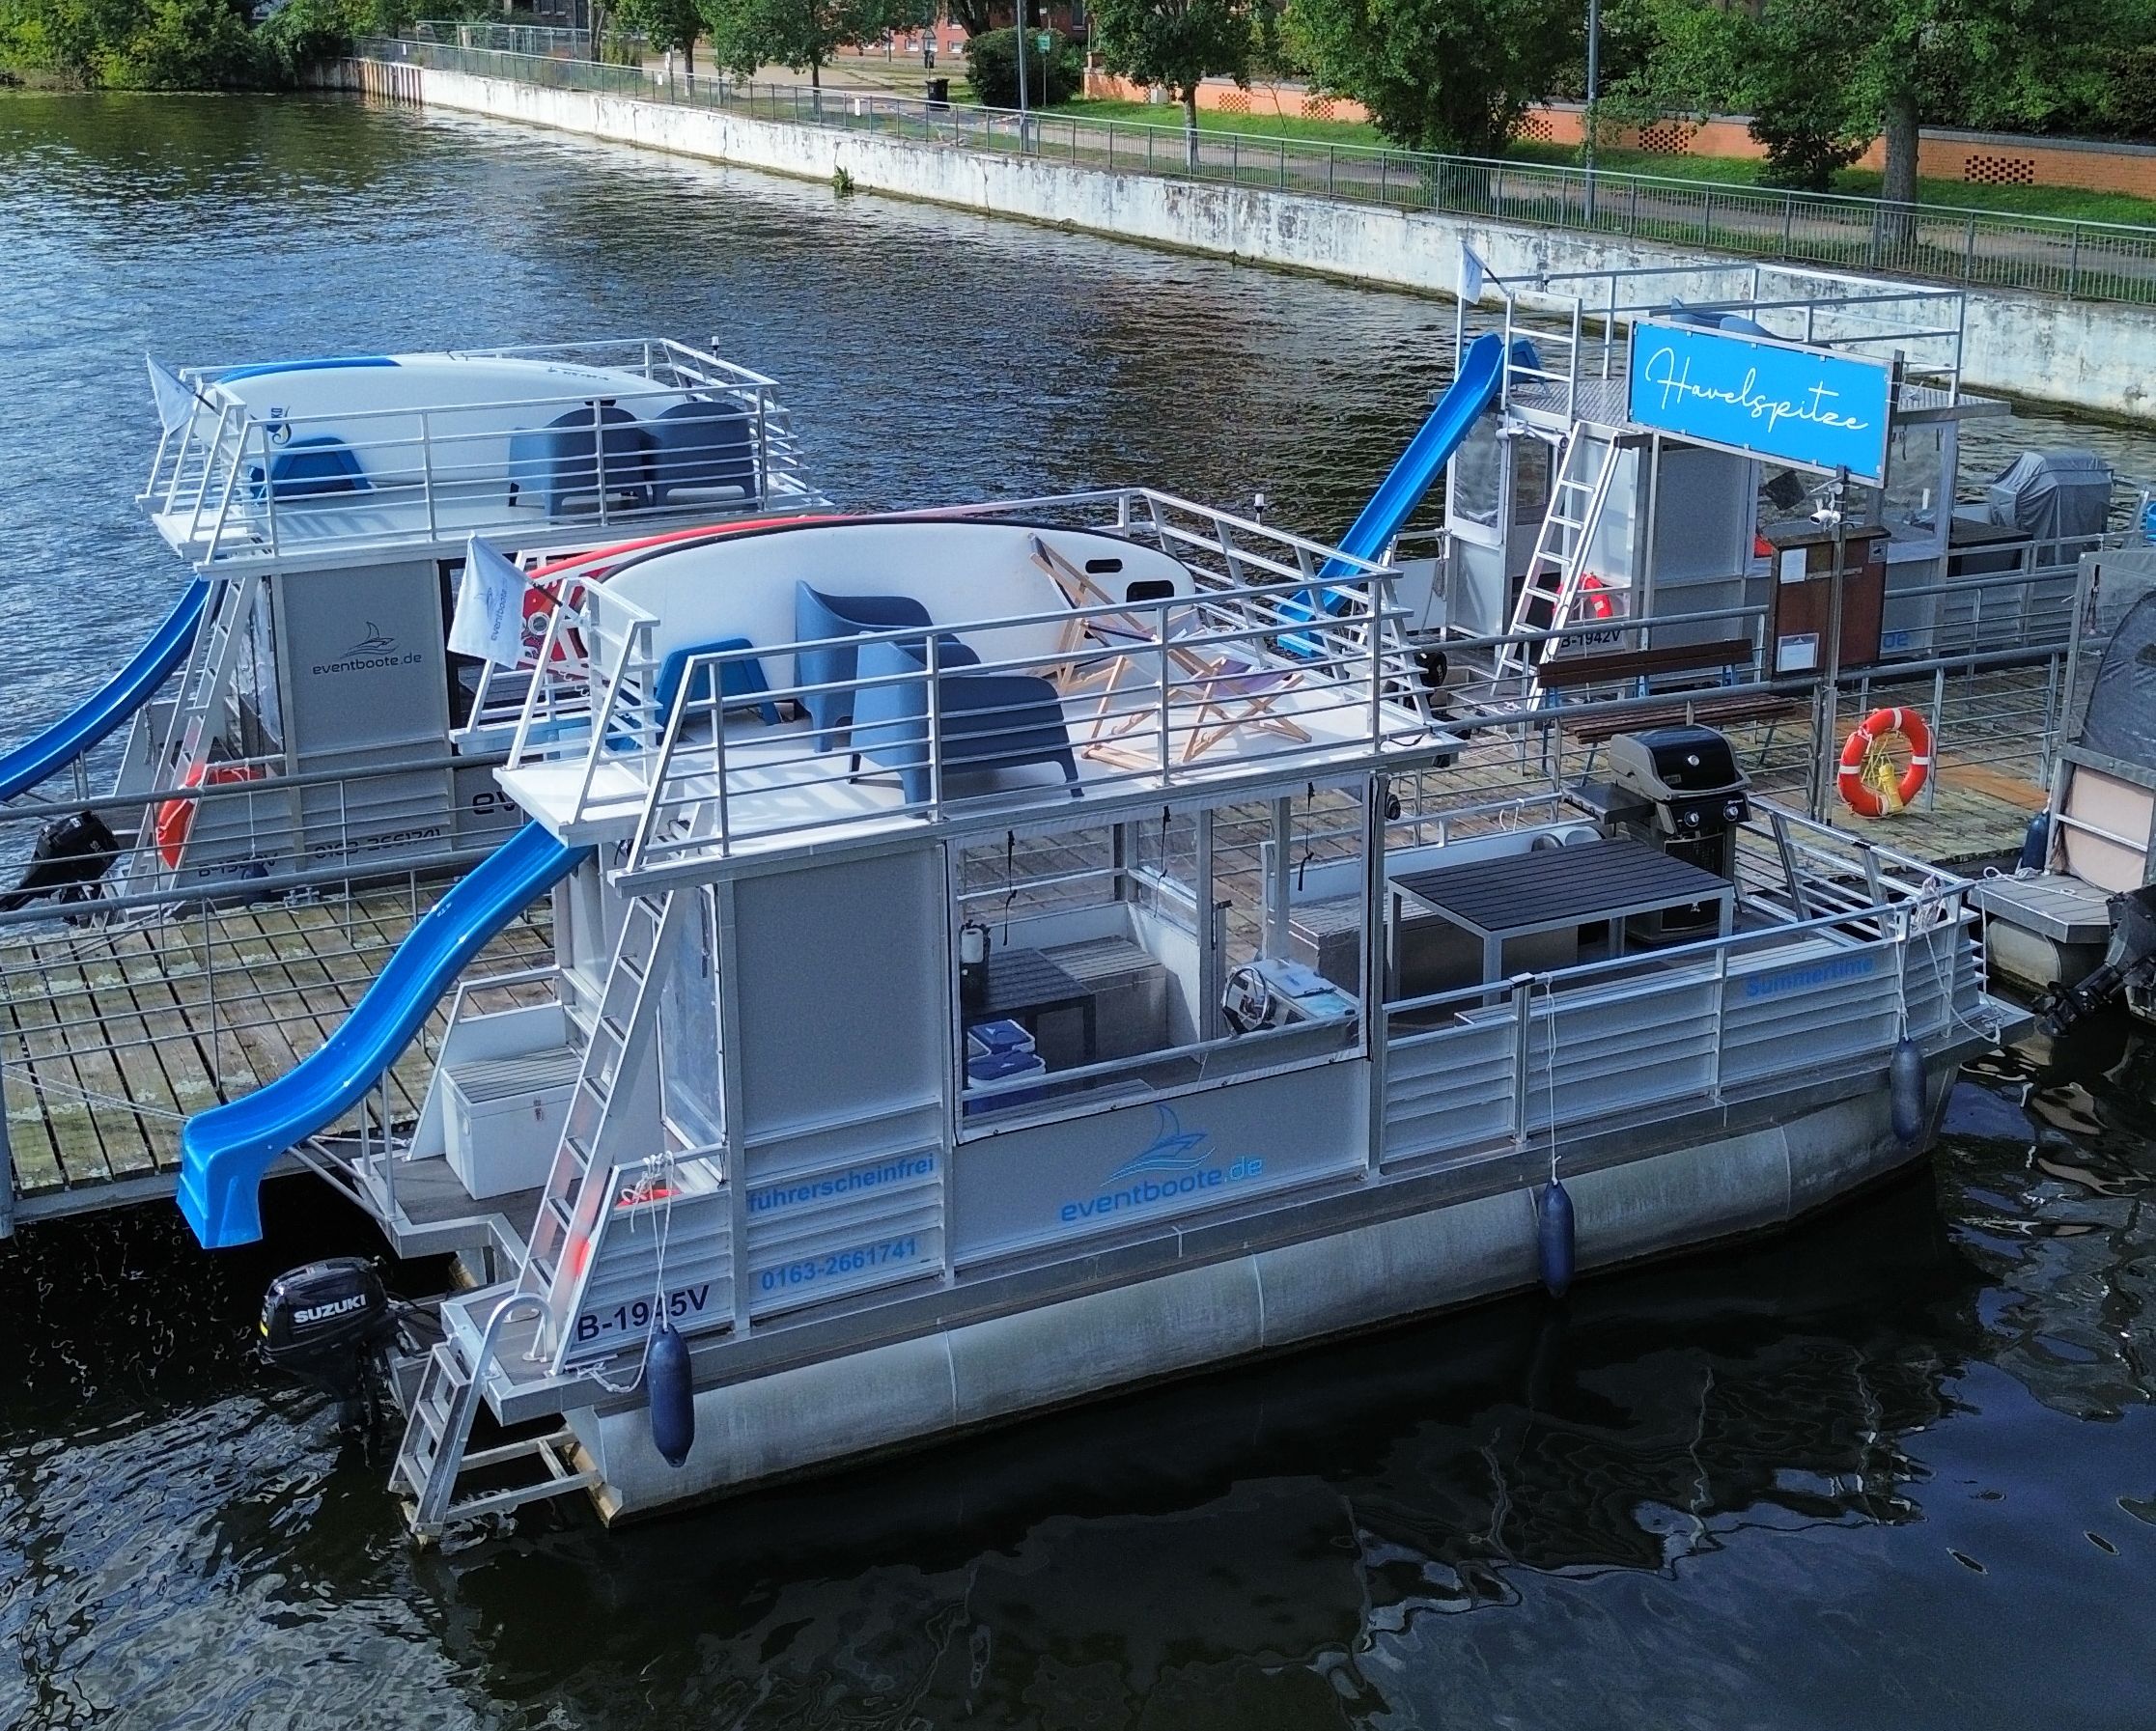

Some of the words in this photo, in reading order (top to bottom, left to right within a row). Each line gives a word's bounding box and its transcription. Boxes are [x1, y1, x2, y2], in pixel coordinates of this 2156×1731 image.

[1645, 347, 1869, 433] Havelspitze
[313, 652, 422, 675] eventboote.de
[748, 1153, 934, 1213] führerscheinfrei
[1062, 1156, 1263, 1222] eventboote.de
[761, 1238, 916, 1291] 0163-2661741
[294, 1294, 366, 1324] SUZUKI
